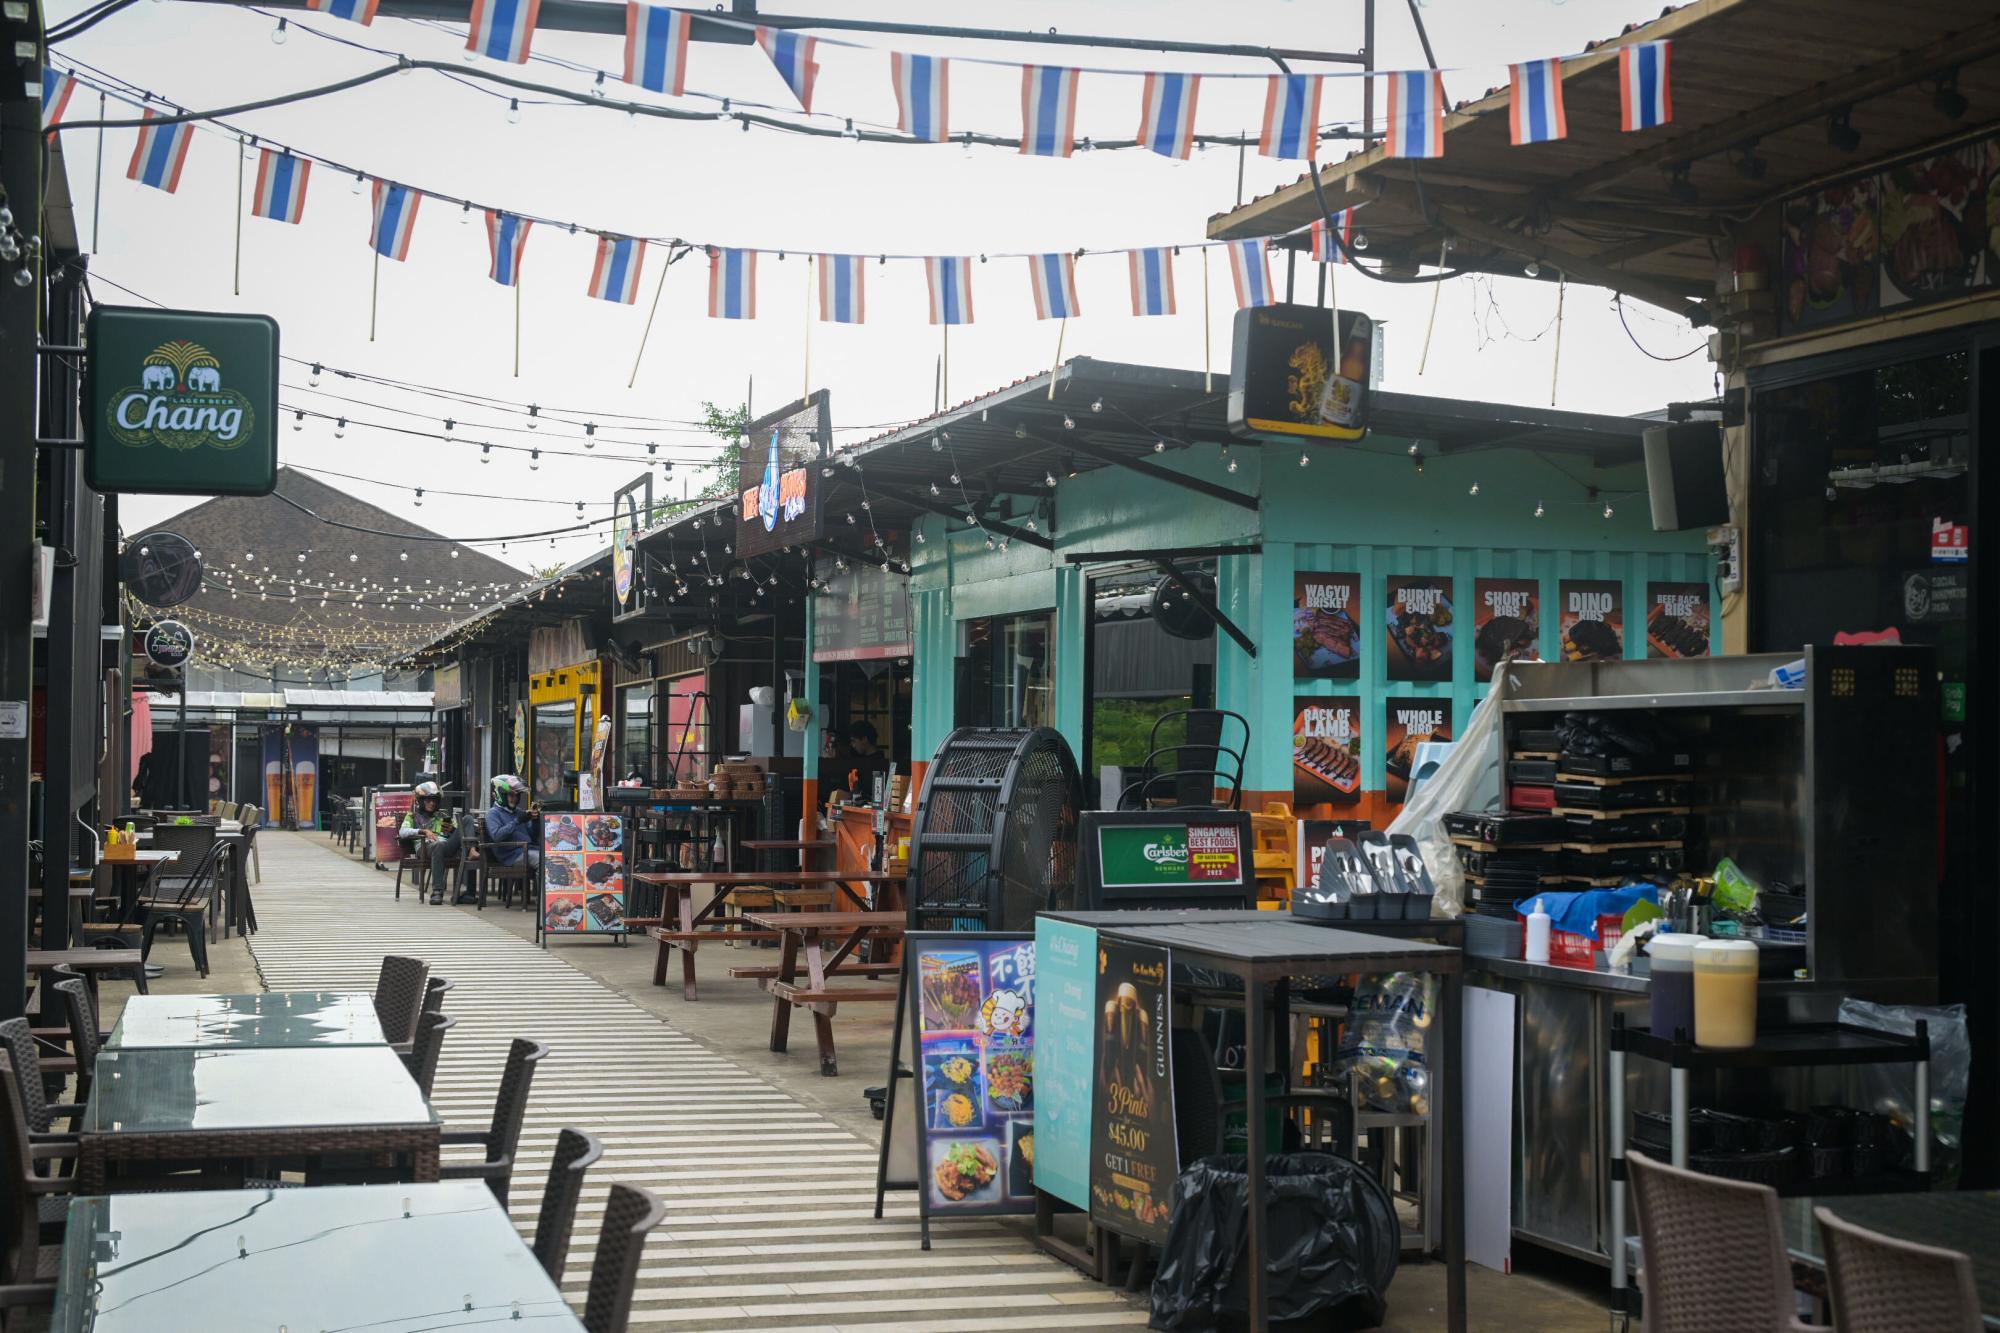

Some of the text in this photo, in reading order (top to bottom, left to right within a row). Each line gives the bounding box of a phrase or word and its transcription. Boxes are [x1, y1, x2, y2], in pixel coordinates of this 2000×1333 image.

[172, 397, 206, 405] LAGER
[116, 393, 243, 441] Chang
[1305, 584, 1350, 600] WAGYU
[1397, 588, 1443, 604] BURNT
[1484, 591, 1529, 607] SHORT
[1656, 594, 1700, 605] BEEF BACK
[1306, 598, 1348, 608] BRISKET
[1405, 601, 1435, 615] ENDS
[1569, 592, 1613, 613] DINO
[1664, 602, 1693, 617] RIBS
[1494, 604, 1520, 618] RIBS
[1578, 610, 1604, 623] RIBS
[1303, 709, 1351, 721] RACK OF
[1397, 709, 1443, 725] WHOLE
[1304, 719, 1350, 738] LAMB
[1407, 723, 1433, 736] BIRD
[1188, 827, 1236, 838] SINGAPORE
[1190, 837, 1235, 847] BEST FOODS
[1156, 993, 1166, 1078] GUINNESS
[1108, 1082, 1149, 1120] 3 Pints
[1105, 1152, 1124, 1172] GET
[1131, 1160, 1157, 1183] FREE
